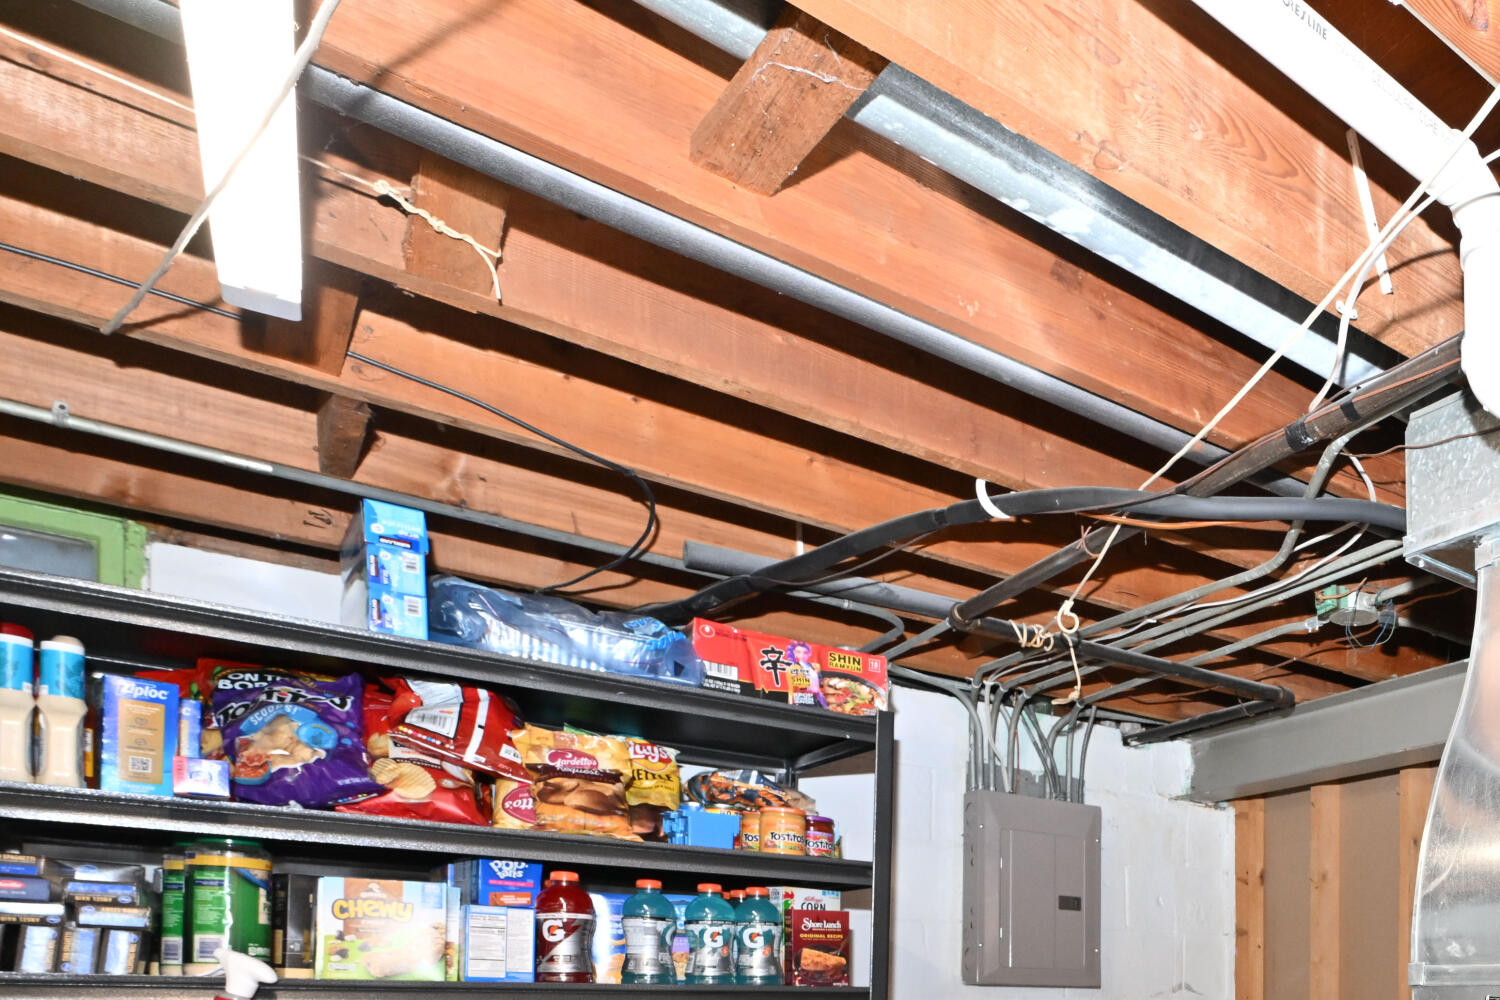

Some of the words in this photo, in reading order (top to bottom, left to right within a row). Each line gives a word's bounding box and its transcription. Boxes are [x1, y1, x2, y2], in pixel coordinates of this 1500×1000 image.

[829, 653, 861, 666] SHIN
[228, 672, 259, 682] ON
[120, 680, 169, 700] Ziploc
[542, 919, 565, 942] G
[703, 927, 723, 948] G
[742, 927, 765, 949] G
